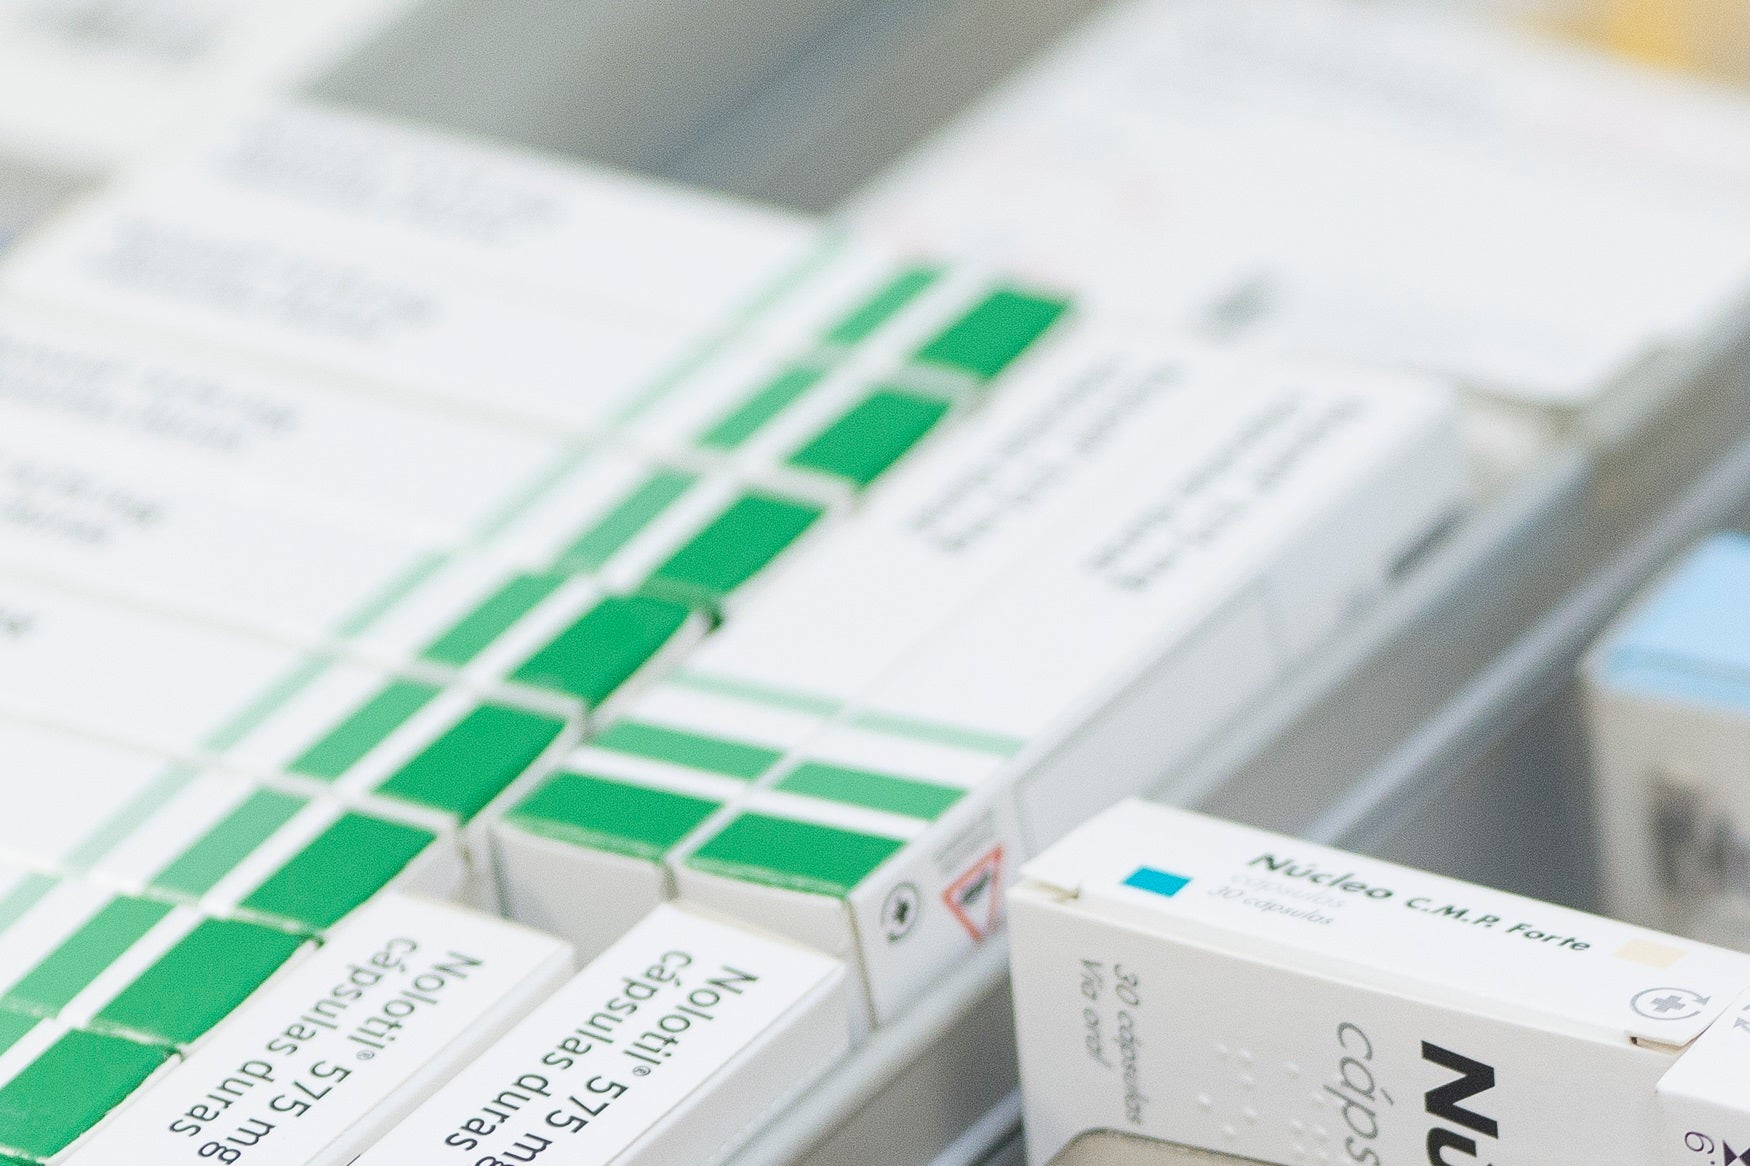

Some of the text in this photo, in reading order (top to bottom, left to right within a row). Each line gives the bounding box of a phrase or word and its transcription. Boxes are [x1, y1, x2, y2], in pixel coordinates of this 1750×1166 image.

[1247, 850, 1394, 901] Núcleo
[1505, 921, 1592, 953] Forte
[1113, 962, 1141, 1007] 30
[169, 936, 421, 1137] cápsulas duras
[444, 948, 694, 1152] cápsulas duras
[273, 1062, 352, 1119] 575
[547, 1078, 628, 1133] 575
[197, 1119, 276, 1166] mg
